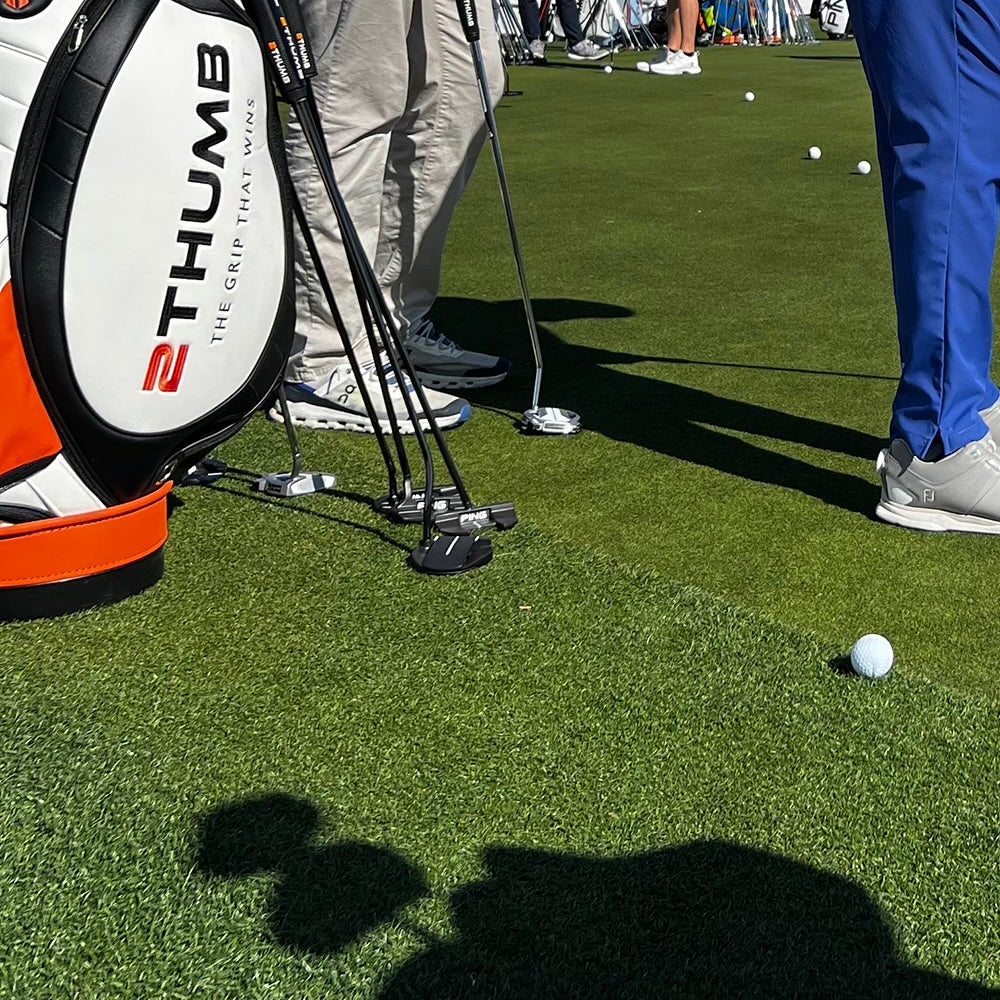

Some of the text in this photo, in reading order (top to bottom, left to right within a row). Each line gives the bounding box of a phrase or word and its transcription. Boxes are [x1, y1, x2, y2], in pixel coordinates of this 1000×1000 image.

[210, 98, 256, 345] THE GRIP THAT WINS
[416, 500, 448, 511] PNG
[460, 510, 488, 523] PING
